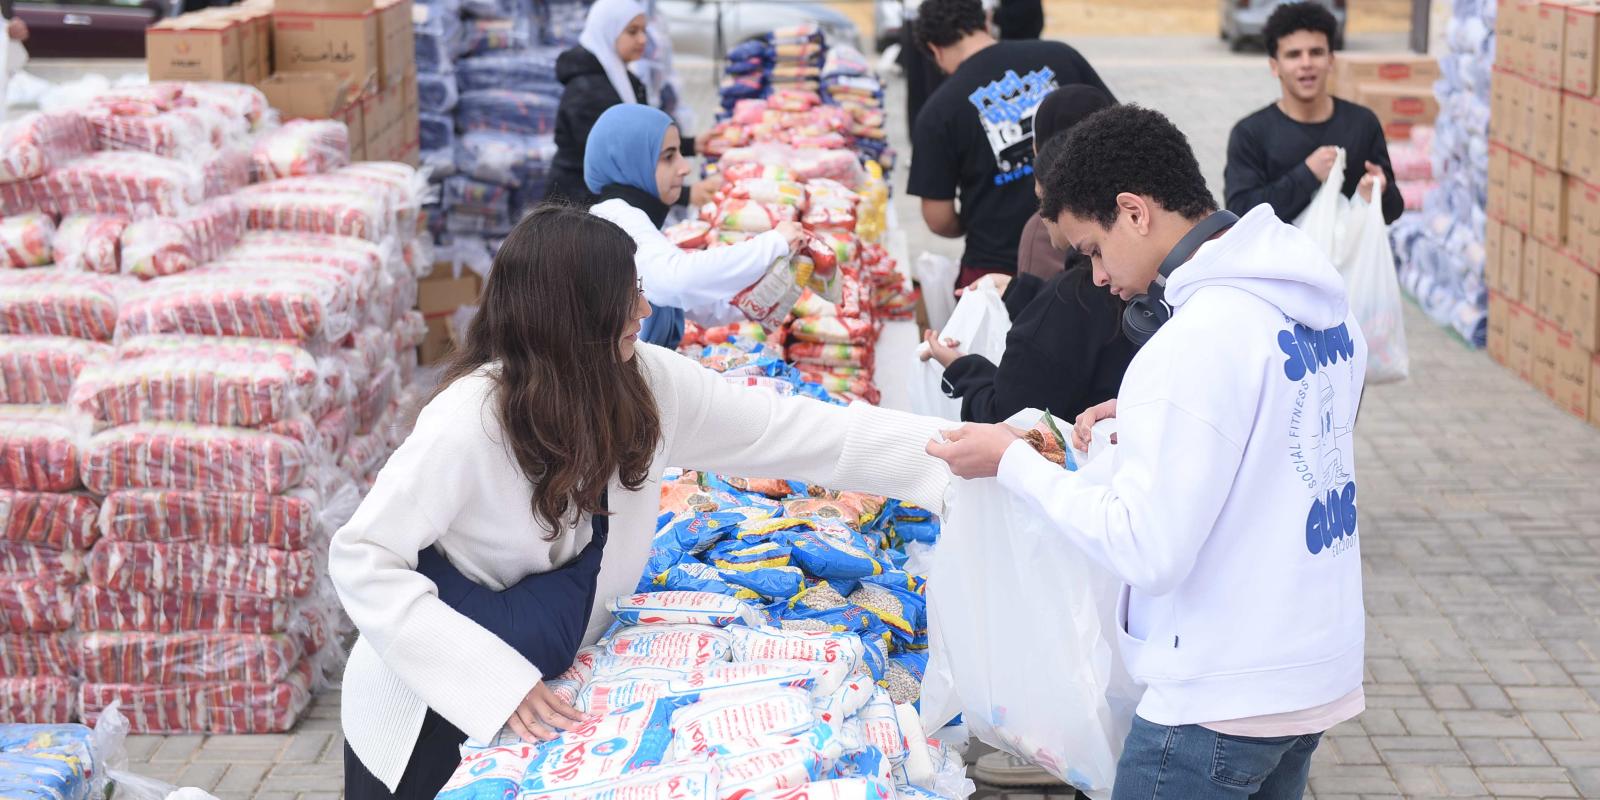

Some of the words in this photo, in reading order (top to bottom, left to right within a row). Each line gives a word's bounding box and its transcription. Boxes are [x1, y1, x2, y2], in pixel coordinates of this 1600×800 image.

[1288, 380, 1309, 438] FITNESS
[1289, 443, 1317, 489] SOCIAL
[1306, 481, 1356, 555] CLUB
